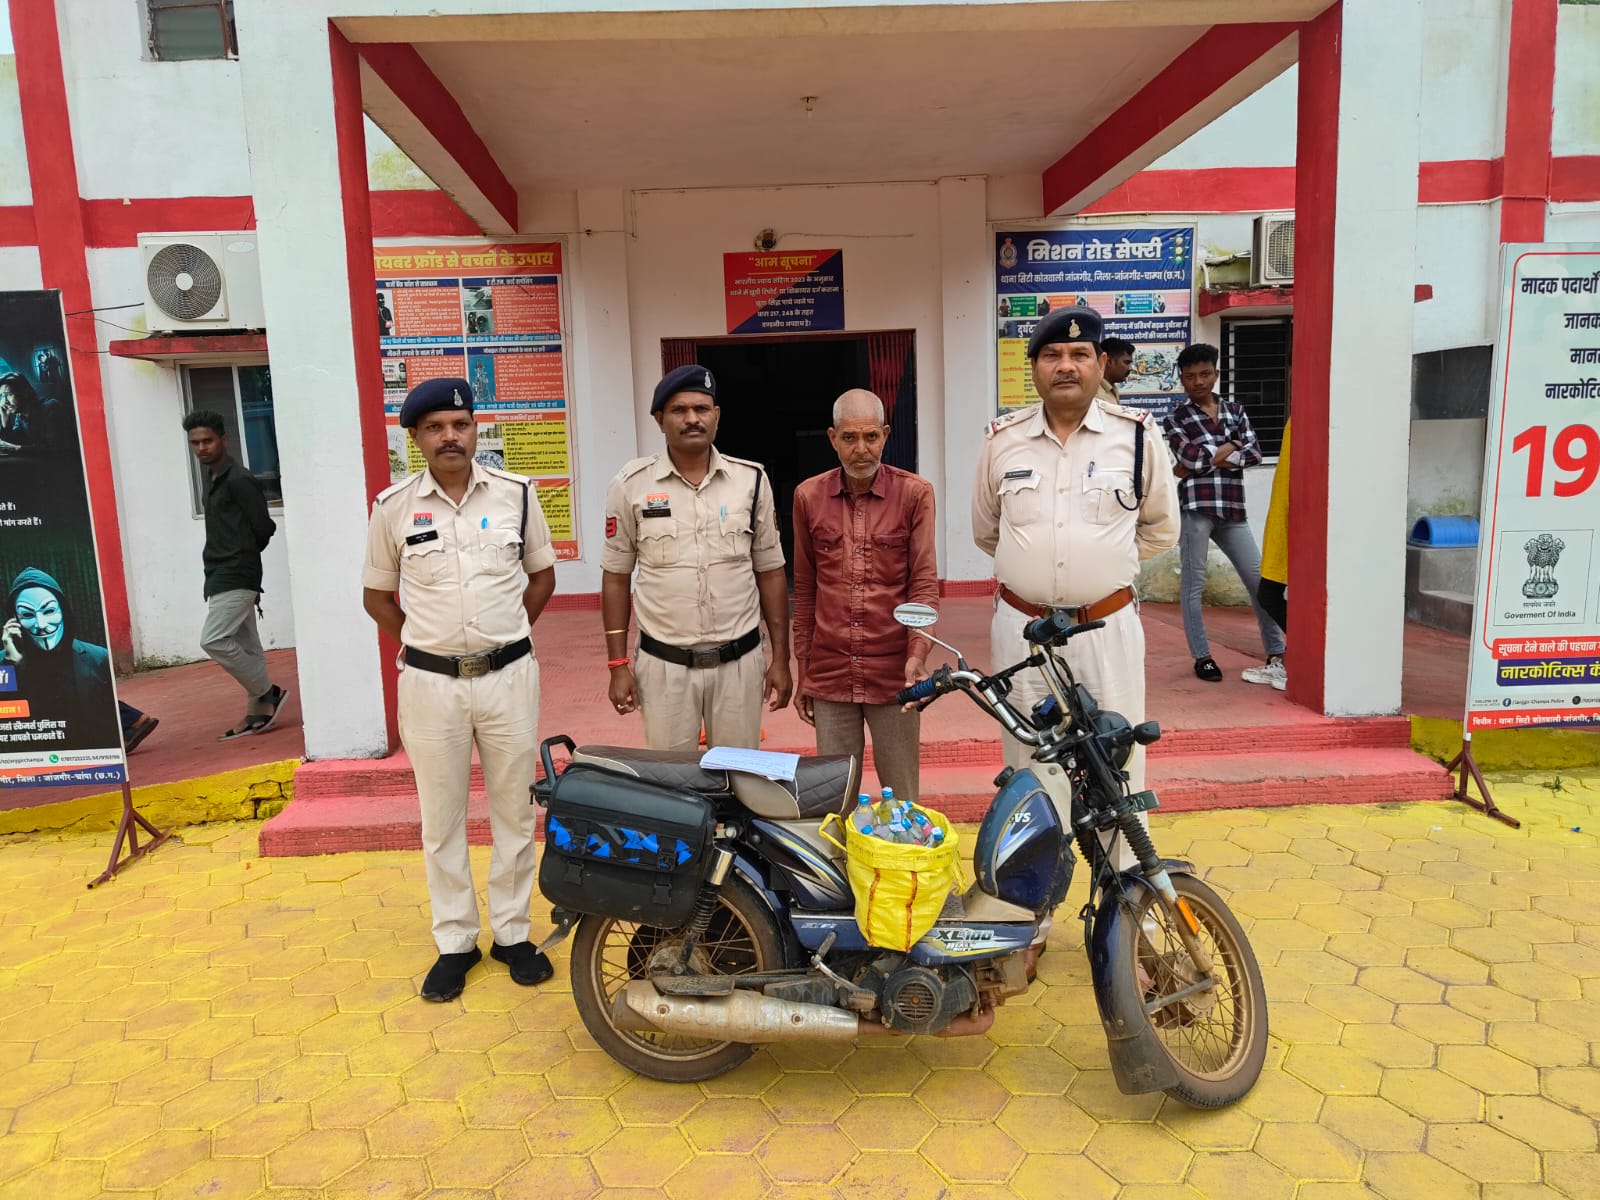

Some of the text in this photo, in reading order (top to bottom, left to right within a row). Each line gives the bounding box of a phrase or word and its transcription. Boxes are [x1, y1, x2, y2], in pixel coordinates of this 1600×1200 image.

[1027, 236, 1162, 260] मिशन रोड सेफ्टी
[376, 249, 554, 268] ायबर फ्रॉड से बचने के उपाय
[1000, 274, 1016, 283] थाना
[1018, 272, 1033, 283] सिटी
[1034, 272, 1064, 282] कोतवाली
[1521, 278, 1559, 294] मादक
[1017, 322, 1037, 337] दुर्घट
[1570, 348, 1600, 364] मान
[1498, 643, 1522, 656] सूचना
[1524, 641, 1537, 653] देने
[1539, 641, 1555, 653] वाले
[1557, 640, 1568, 651] की
[1570, 642, 1596, 652] पहचान
[1500, 662, 1587, 679] नारकोटिक्स
[1516, 716, 1530, 724] सिटी
